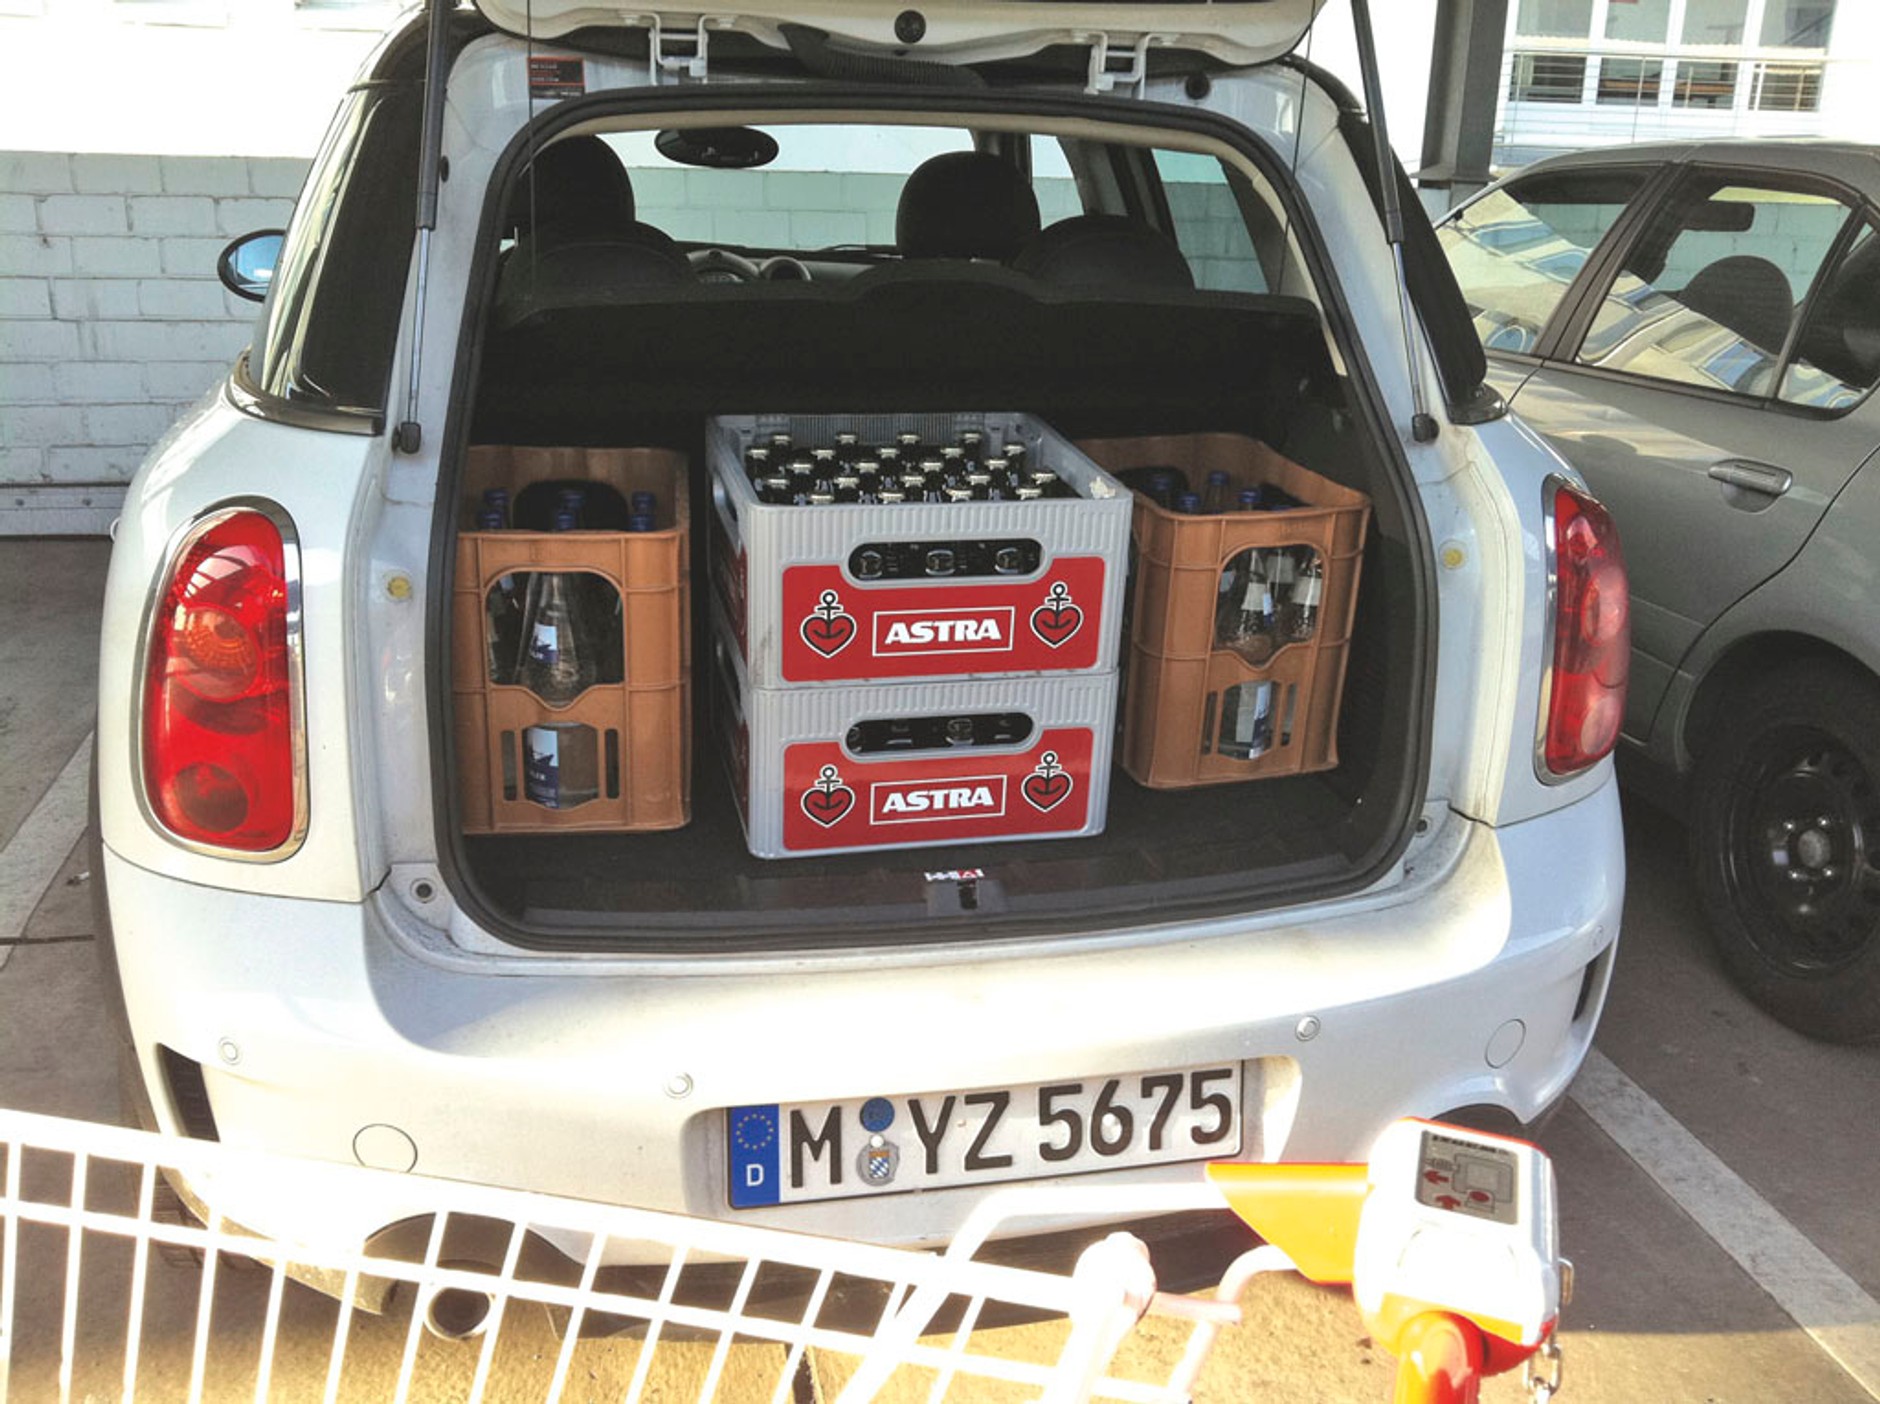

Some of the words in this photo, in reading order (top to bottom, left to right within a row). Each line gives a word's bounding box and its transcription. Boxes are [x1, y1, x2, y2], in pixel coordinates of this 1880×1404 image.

[884, 617, 1002, 646] ASTRA
[882, 786, 995, 814] ASTRA
[790, 1105, 842, 1188] M
[907, 1090, 1013, 1175] YZ
[1038, 1068, 1233, 1162] 5675
[746, 1163, 764, 1187] D
